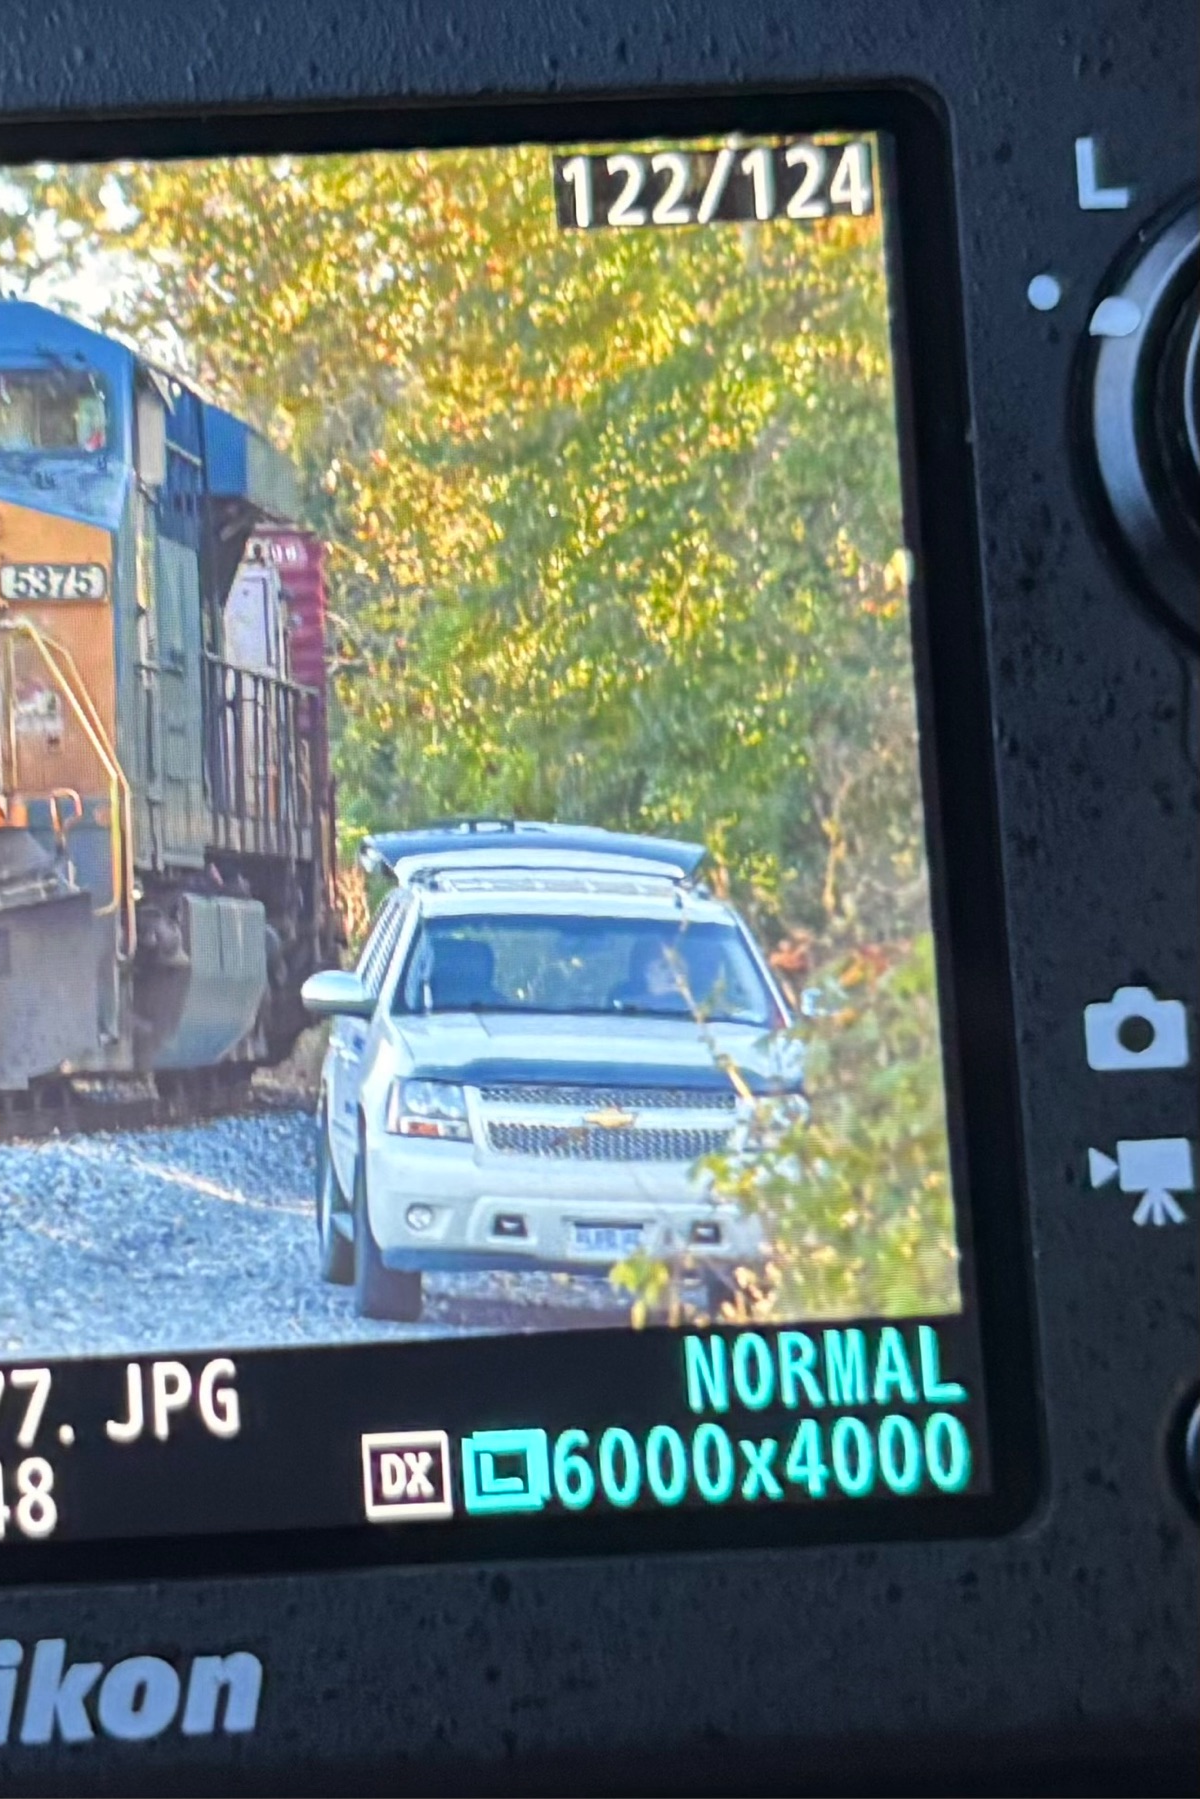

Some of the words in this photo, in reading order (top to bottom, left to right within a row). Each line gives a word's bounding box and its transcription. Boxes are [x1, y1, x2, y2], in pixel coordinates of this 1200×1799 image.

[561, 141, 873, 228] 122/124
[1075, 136, 1131, 209] L
[12, 565, 94, 600] 5375
[682, 1325, 967, 1412] NORMAL
[380, 1452, 437, 1499] DX
[552, 1412, 970, 1511] 6000x4000
